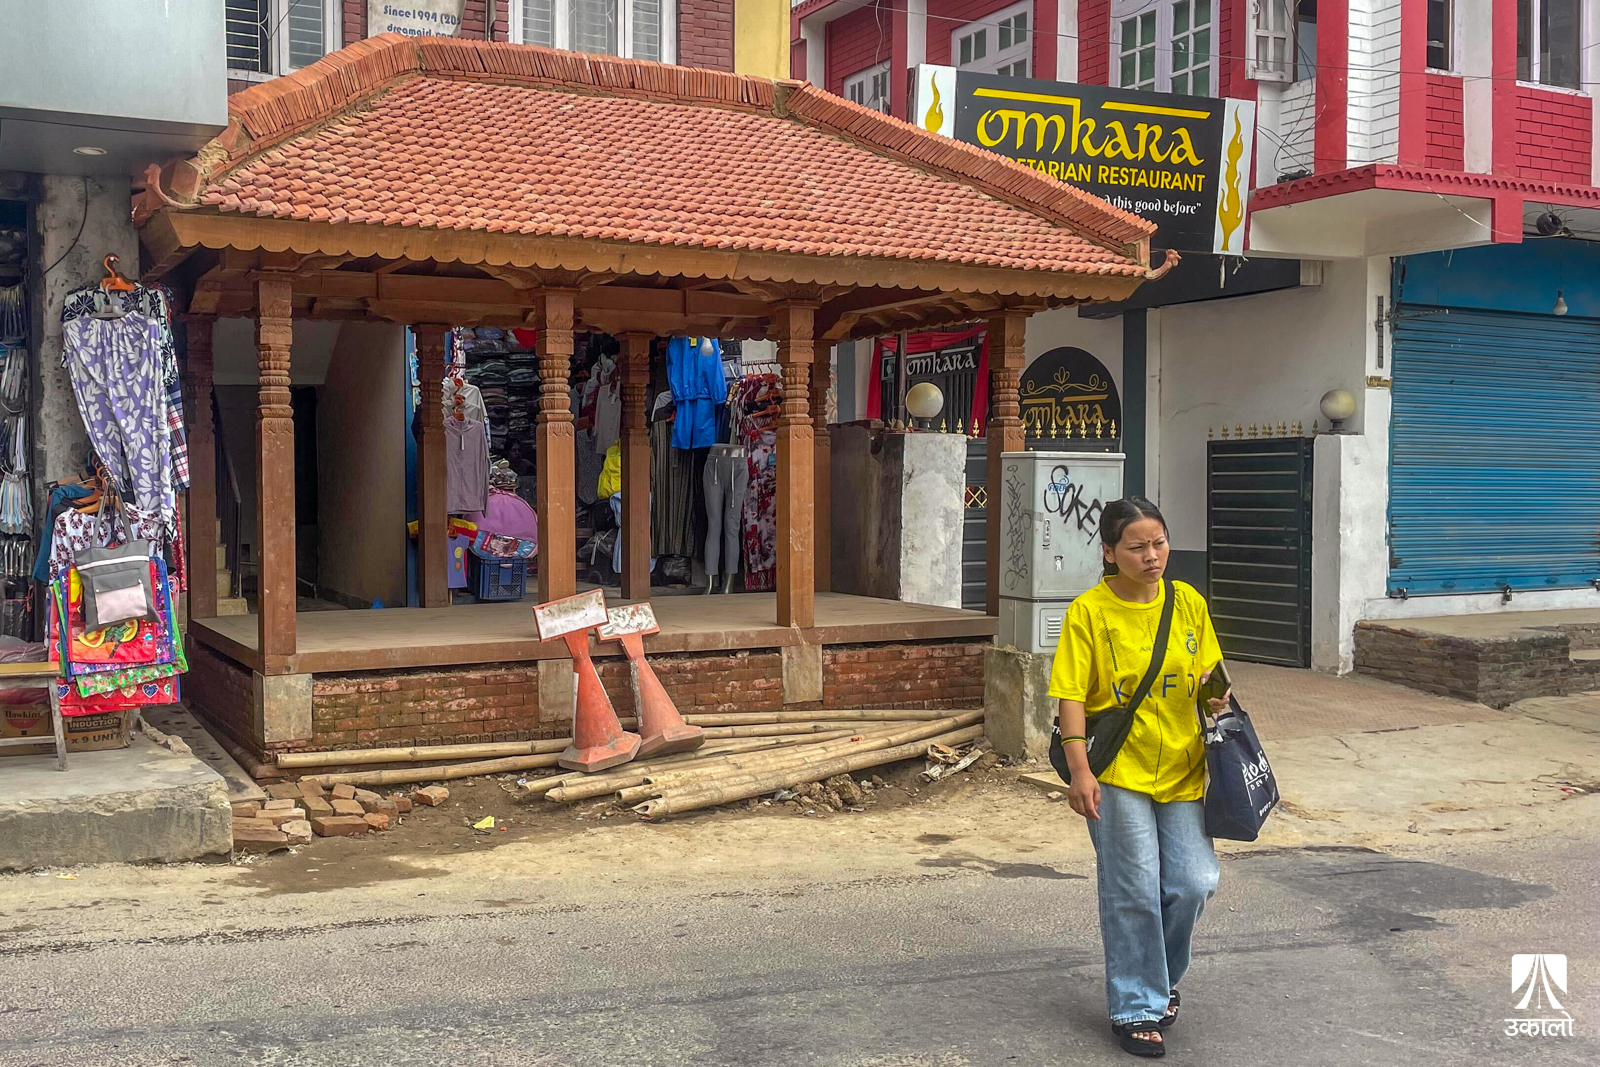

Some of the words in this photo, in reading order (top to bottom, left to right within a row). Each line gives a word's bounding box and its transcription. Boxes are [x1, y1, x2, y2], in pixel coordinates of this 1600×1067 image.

[1098, 165, 1206, 193] RESTAURANT
[1134, 199, 1161, 213] good
[1112, 673, 1196, 704] KFD
[69, 718, 120, 728] INDUCTION
